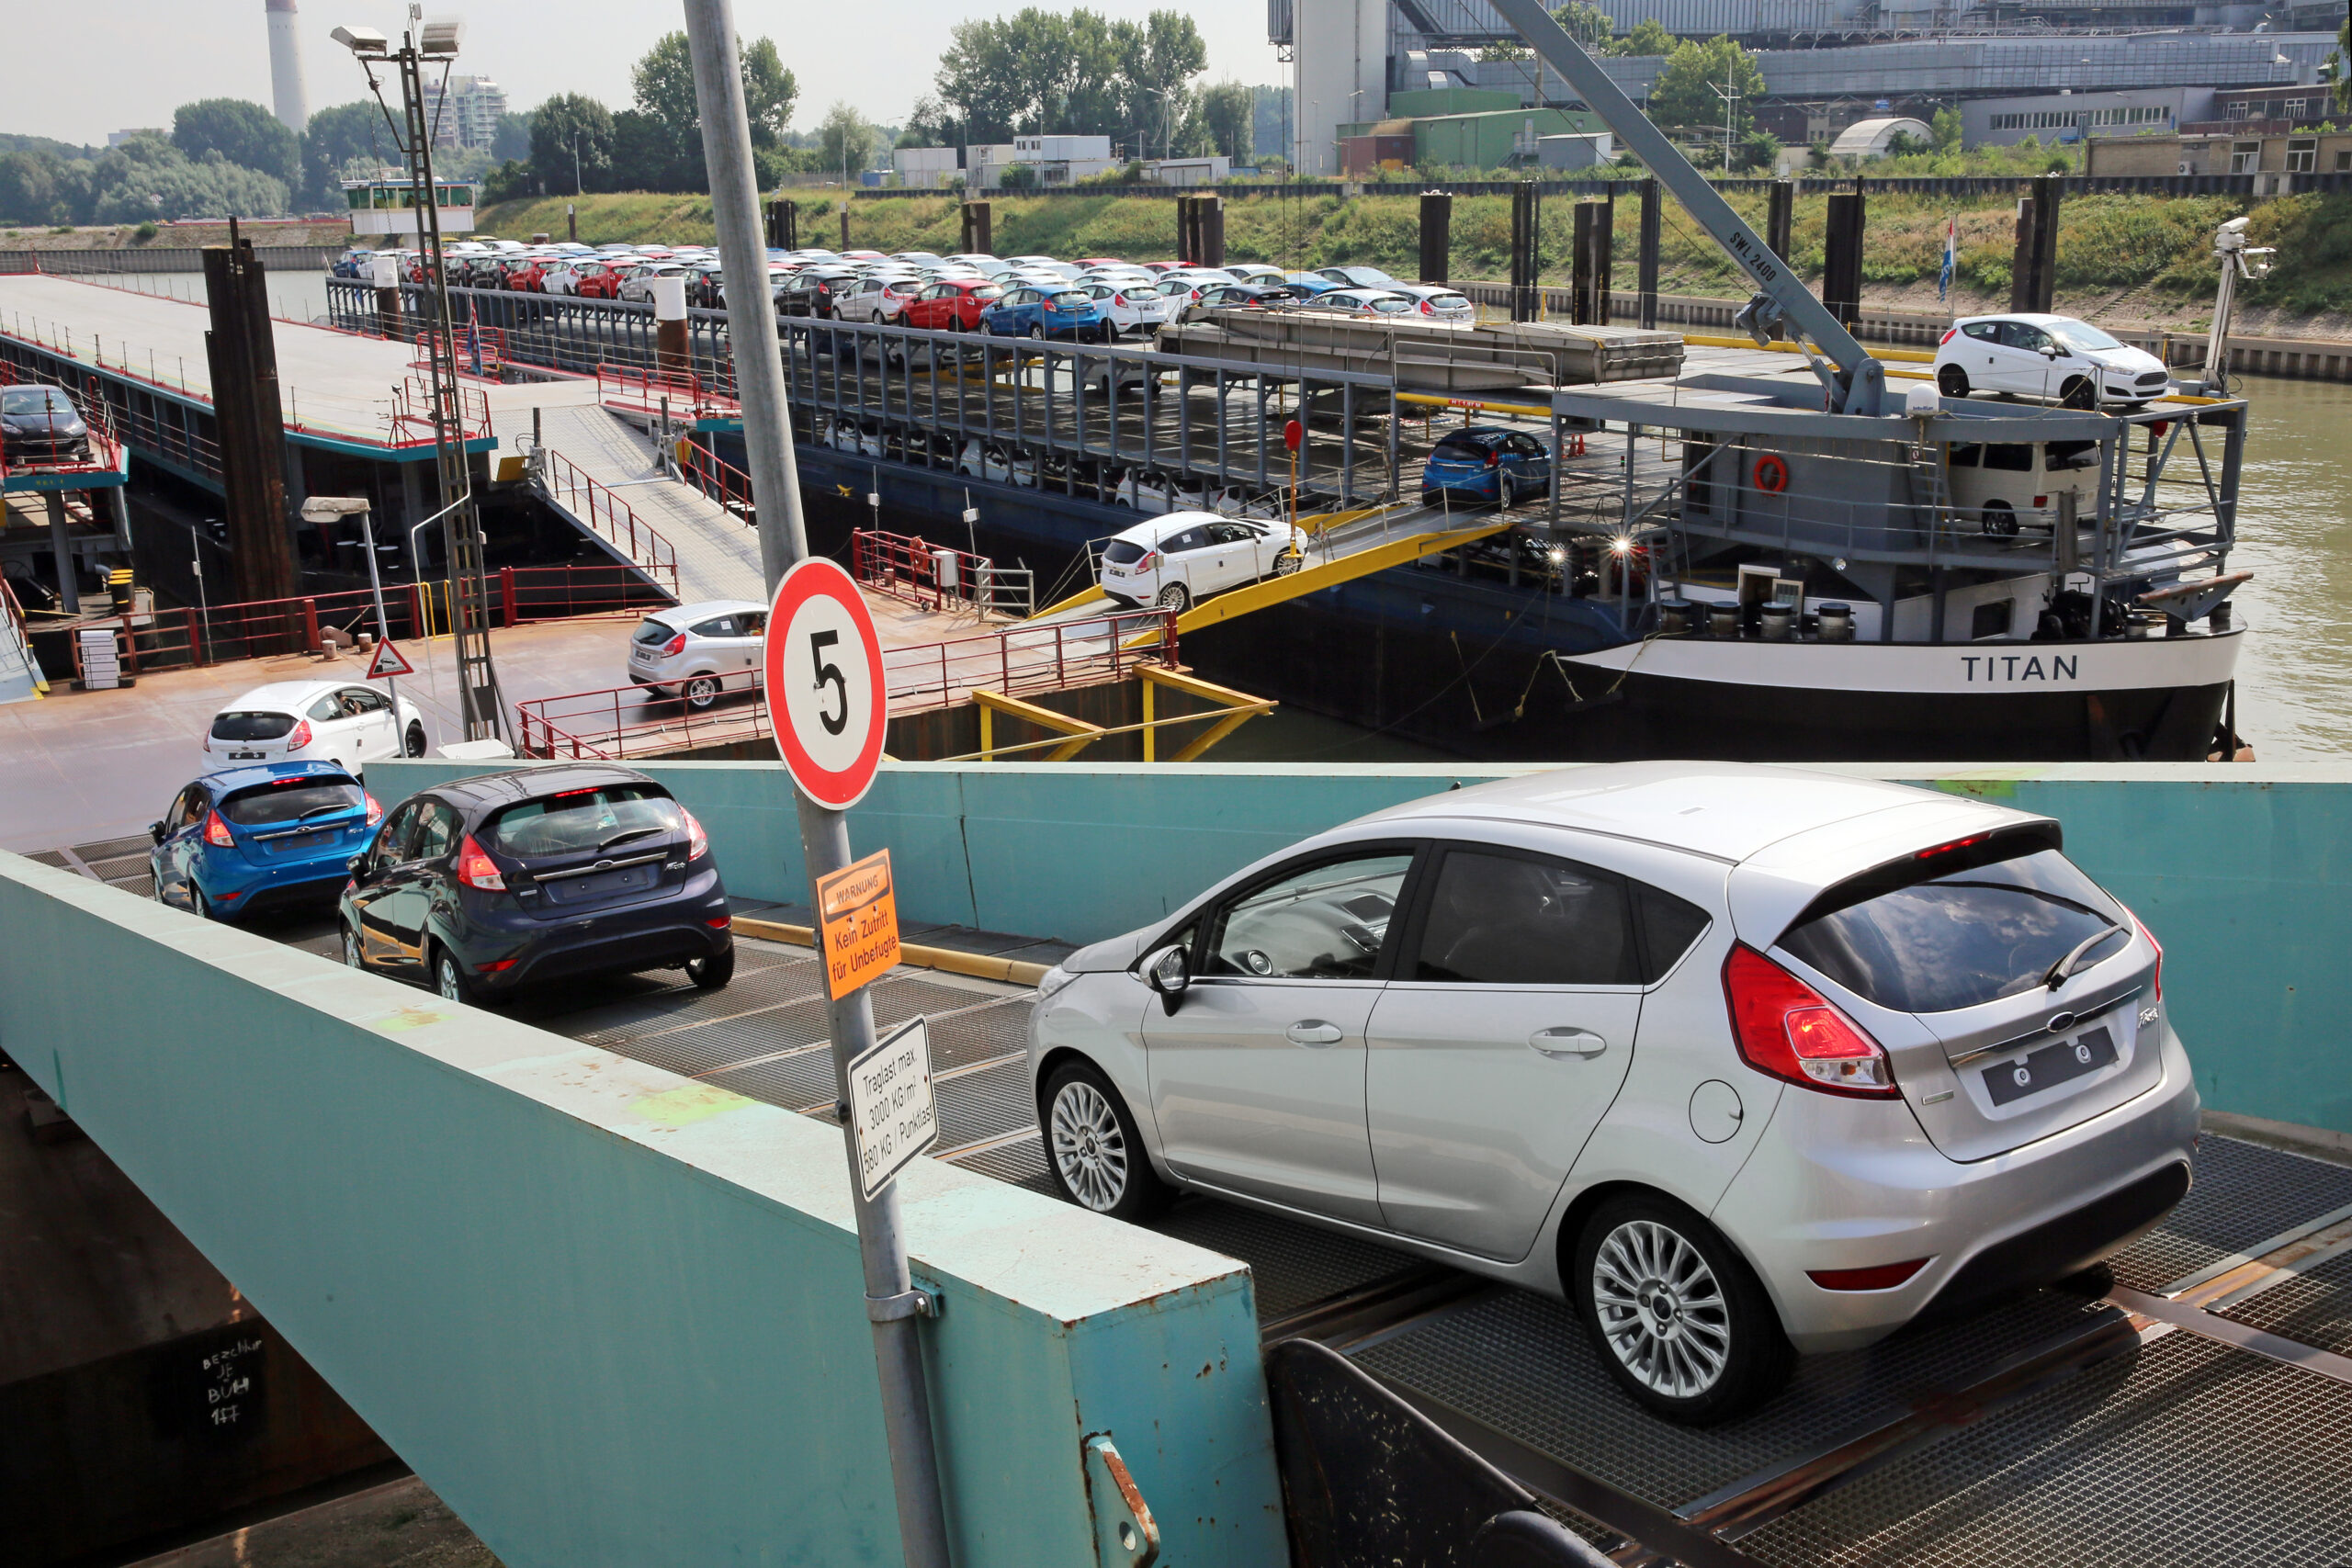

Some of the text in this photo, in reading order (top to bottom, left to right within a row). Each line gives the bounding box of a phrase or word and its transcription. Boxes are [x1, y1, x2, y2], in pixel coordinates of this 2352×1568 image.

[1730, 231, 1777, 282] SWL 2400
[810, 629, 848, 736] 5
[1961, 655, 2077, 682] TITAN
[836, 874, 879, 905] WARNUNG
[834, 910, 889, 953] Kein Zutritt
[832, 934, 897, 983] für Unbefugte
[863, 1047, 918, 1098] Traglast max.
[868, 1097, 890, 1130] 3000
[863, 1146, 879, 1175] 580
[879, 1134, 892, 1161] KG
[899, 1103, 933, 1145] Punktlast
